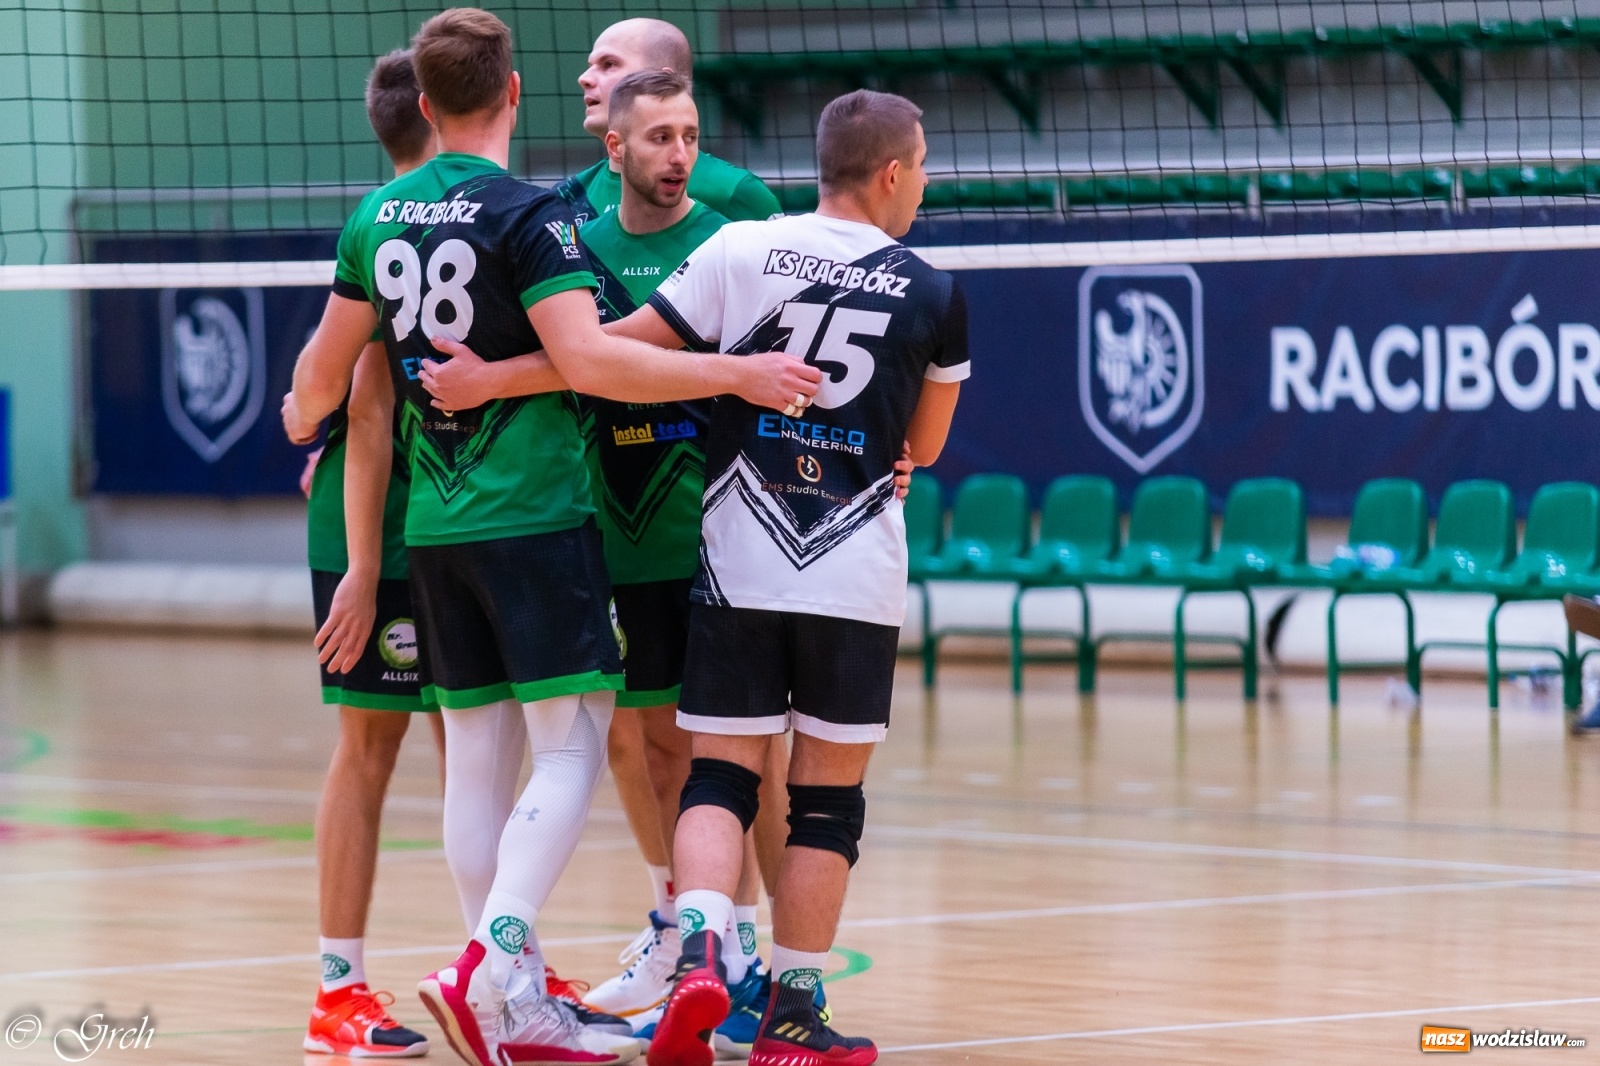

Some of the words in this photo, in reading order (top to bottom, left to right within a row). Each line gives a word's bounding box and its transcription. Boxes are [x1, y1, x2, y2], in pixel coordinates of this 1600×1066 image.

[374, 199, 401, 224] KS
[396, 190, 482, 224] RACIBÓRZ
[562, 245, 579, 254] PCS
[622, 266, 661, 276] ALLSIX
[763, 249, 800, 276] KS
[796, 256, 911, 298] RACIBÓRZ
[374, 238, 477, 342] 98
[777, 301, 893, 410] 15
[761, 482, 783, 492] EMS
[786, 484, 819, 495] Studio
[382, 671, 419, 681] ALLSIX
